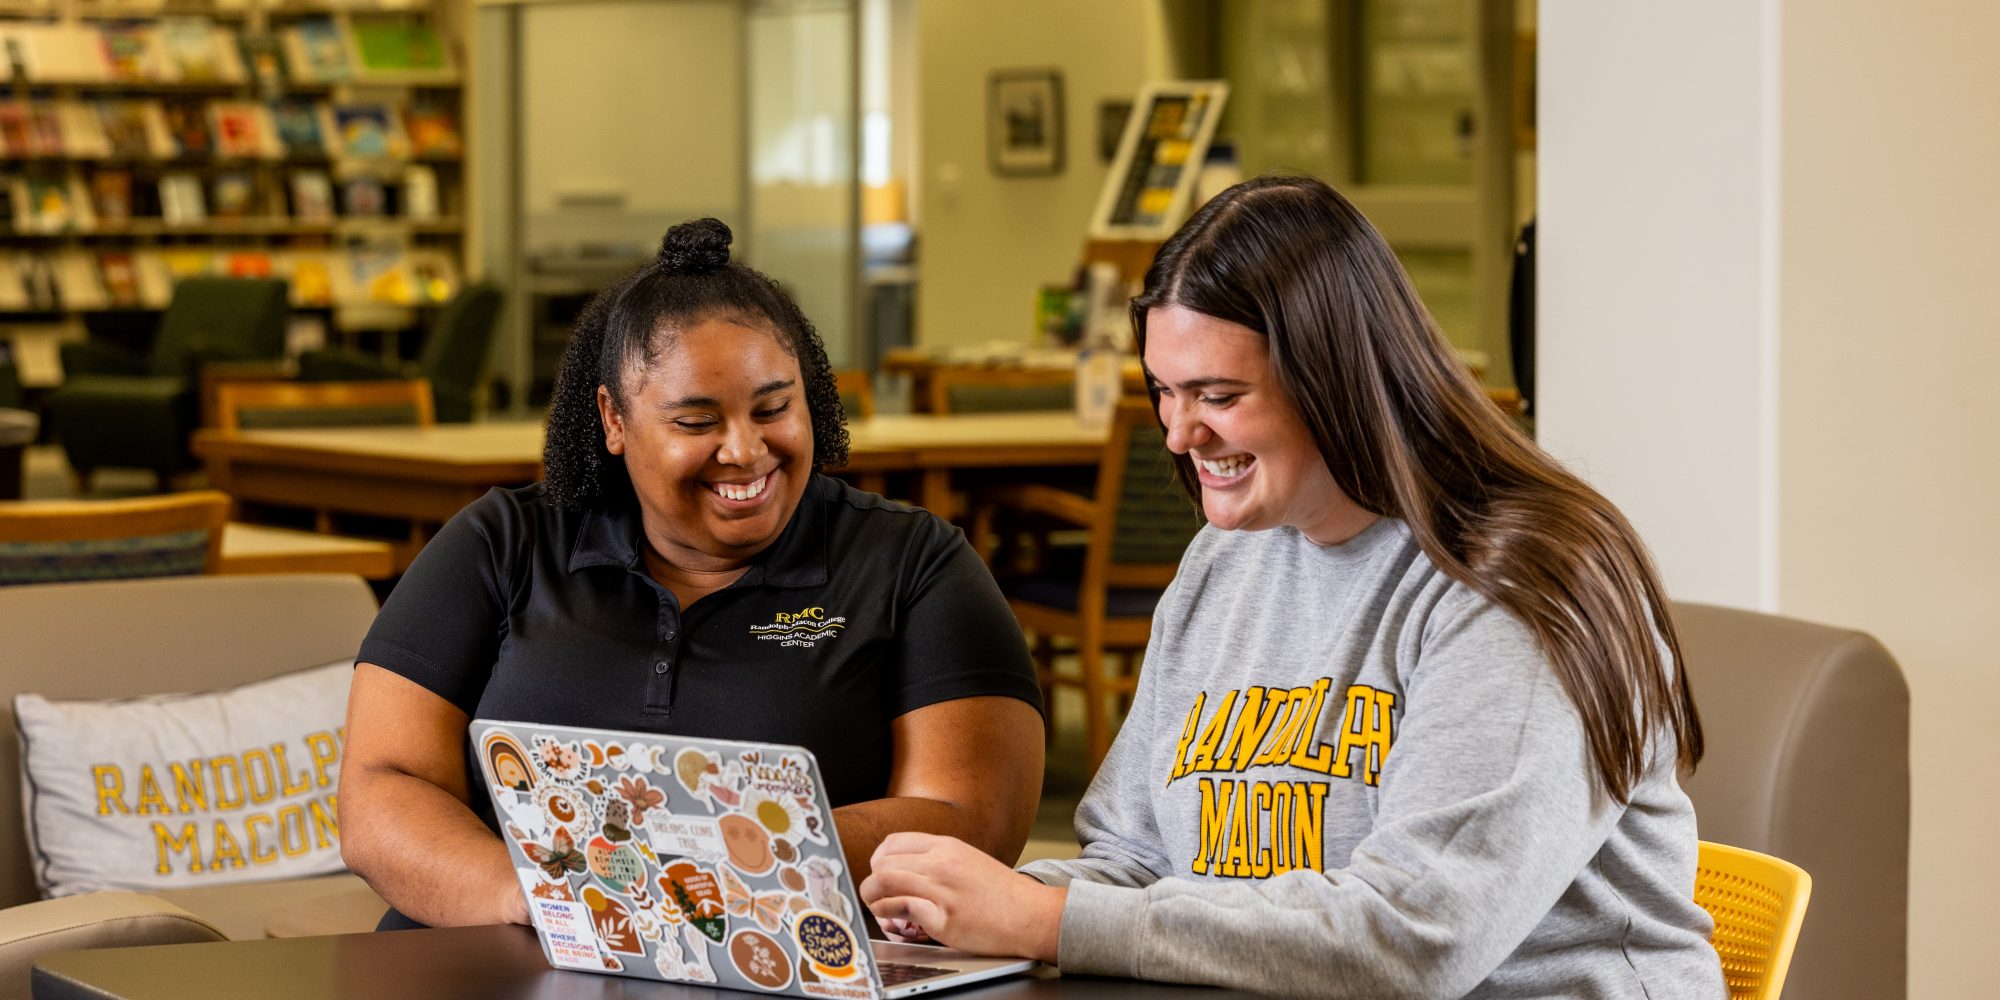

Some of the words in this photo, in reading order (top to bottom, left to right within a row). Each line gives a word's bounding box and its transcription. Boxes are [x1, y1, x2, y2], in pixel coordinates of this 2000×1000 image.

[775, 607, 824, 624] RMC
[817, 616, 846, 628] College
[757, 633, 793, 641] HIGGINS
[793, 630, 837, 641] ACADEMIC
[780, 639, 815, 648] CENTER
[92, 727, 346, 816] RANDOLP
[1192, 777, 1330, 878] MACON
[594, 855, 635, 866] REMEMBER
[540, 902, 570, 912] WOMEN
[542, 910, 575, 920] BELONG
[550, 932, 577, 942] WHERE
[805, 931, 847, 948] STRONG
[552, 940, 595, 951] DECISIONS
[571, 949, 597, 959] BEING
[808, 946, 851, 964] WOMAN
